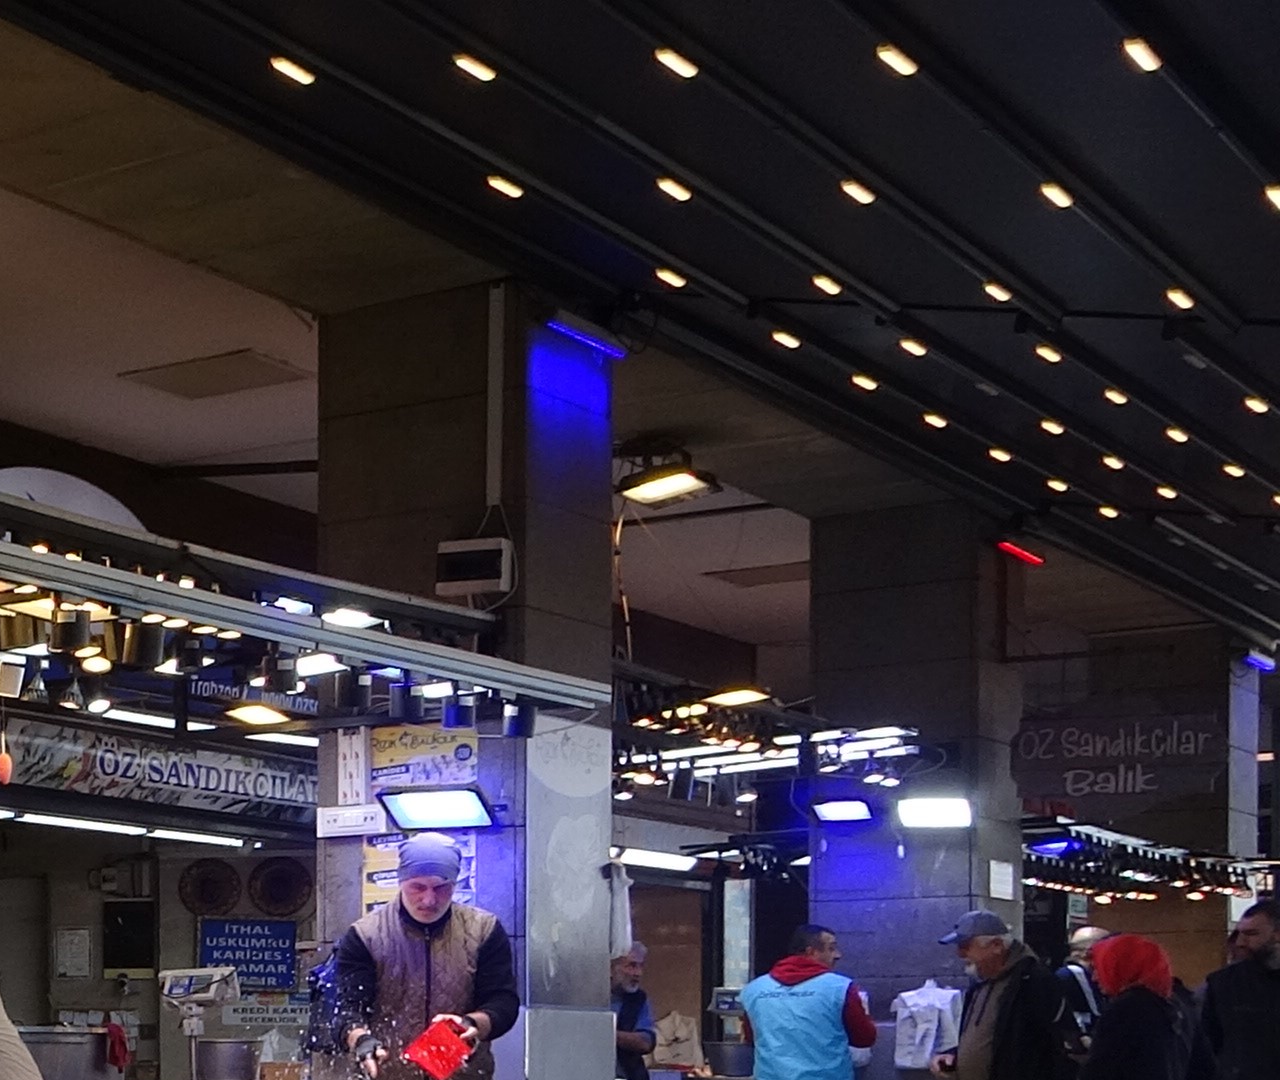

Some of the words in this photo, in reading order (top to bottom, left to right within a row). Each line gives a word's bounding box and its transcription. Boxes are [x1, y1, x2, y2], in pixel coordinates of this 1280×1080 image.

[98, 739, 138, 780] ÖZ
[224, 922, 272, 935] İTHAL
[232, 1005, 269, 1015] KREDİ
